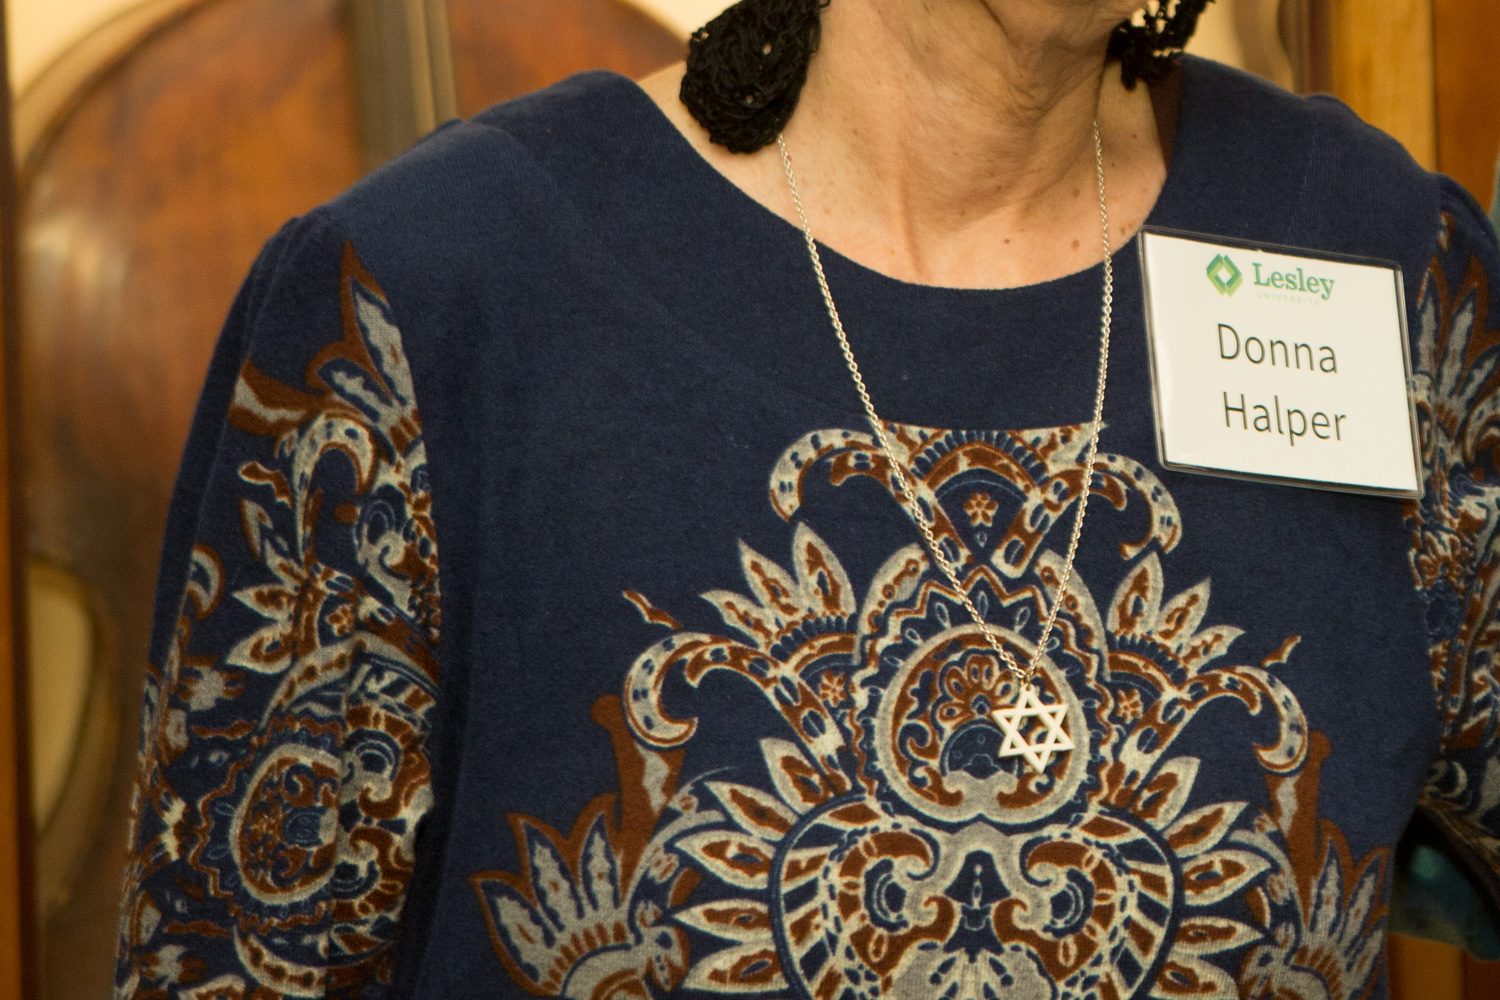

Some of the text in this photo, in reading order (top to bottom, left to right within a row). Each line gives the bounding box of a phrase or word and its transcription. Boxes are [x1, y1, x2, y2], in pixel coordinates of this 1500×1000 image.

[1252, 262, 1335, 300] Lesley
[1217, 323, 1338, 373] Donna
[1223, 391, 1347, 447] Halper
